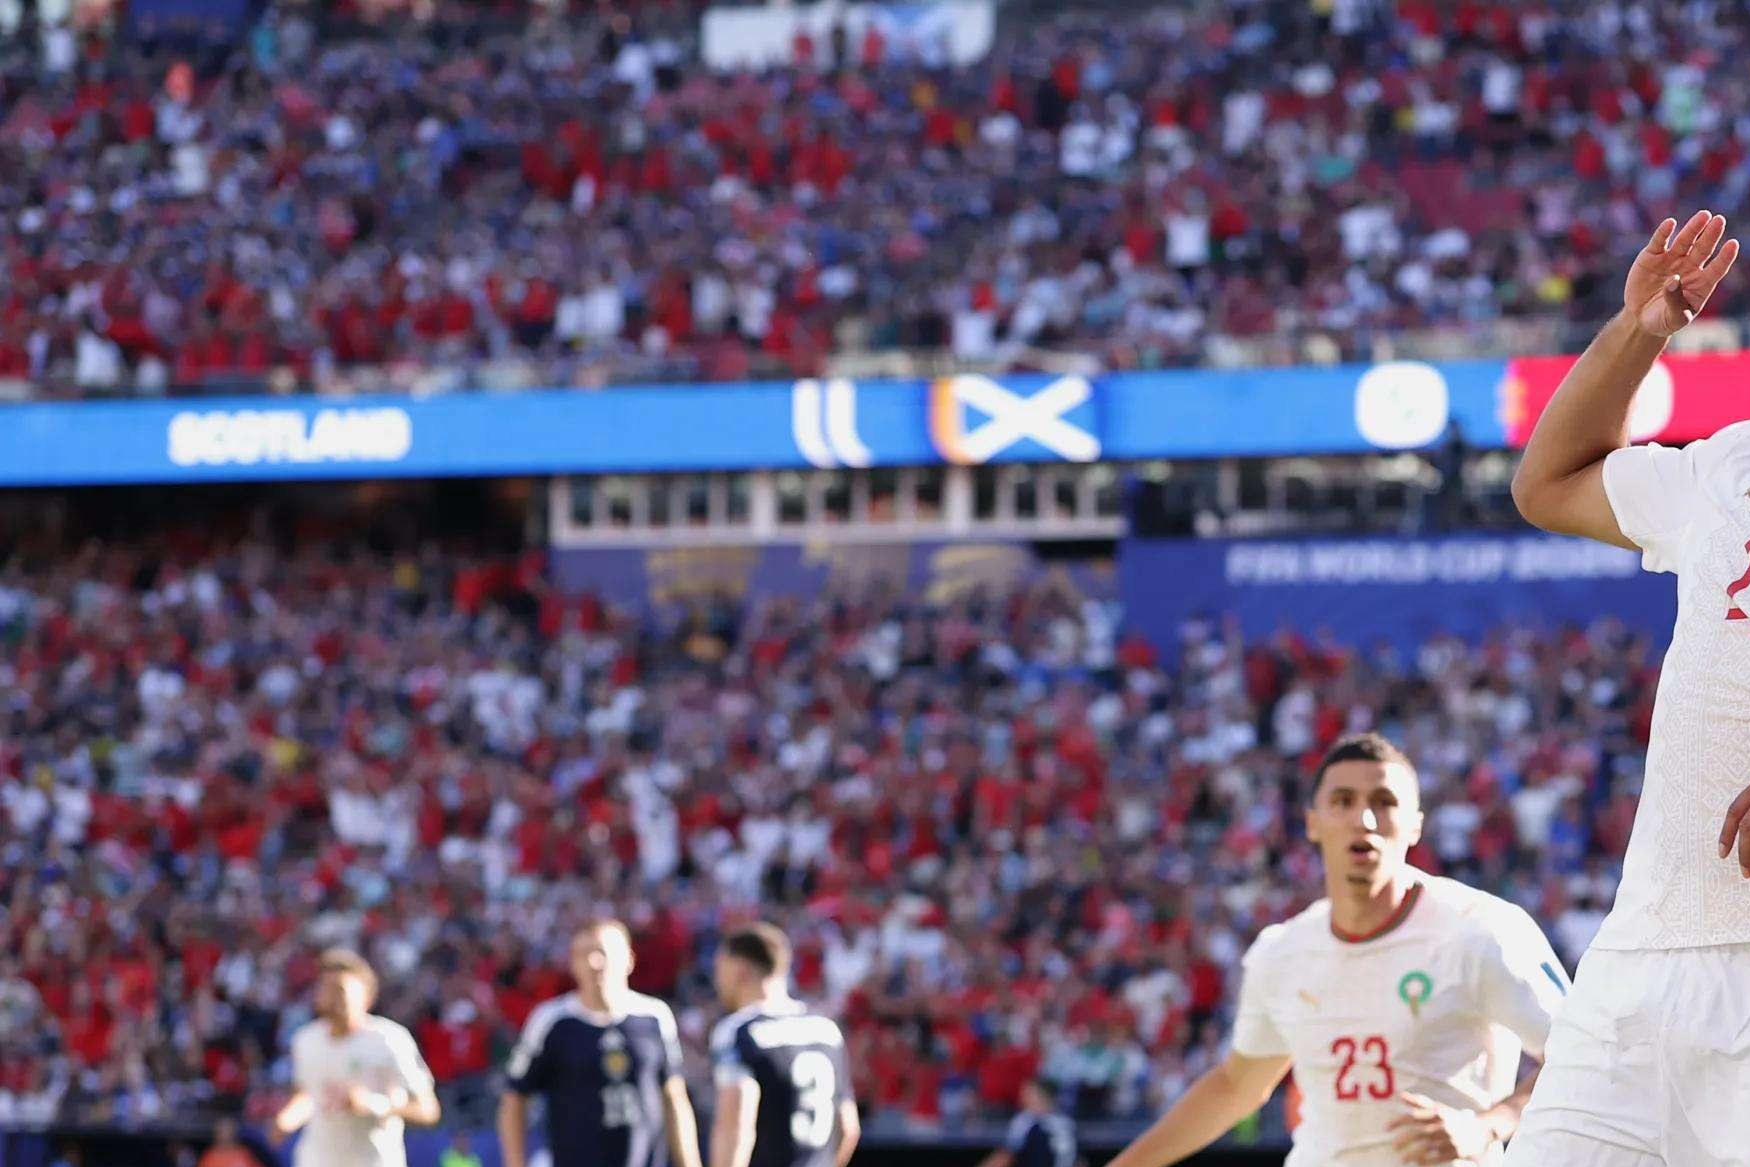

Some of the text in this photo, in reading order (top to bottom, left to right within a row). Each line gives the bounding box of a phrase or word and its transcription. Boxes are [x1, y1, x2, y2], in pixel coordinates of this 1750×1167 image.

[169, 408, 413, 466] SCOTLAND
[789, 1050, 835, 1147] 3
[1331, 1036, 1394, 1100] 23
